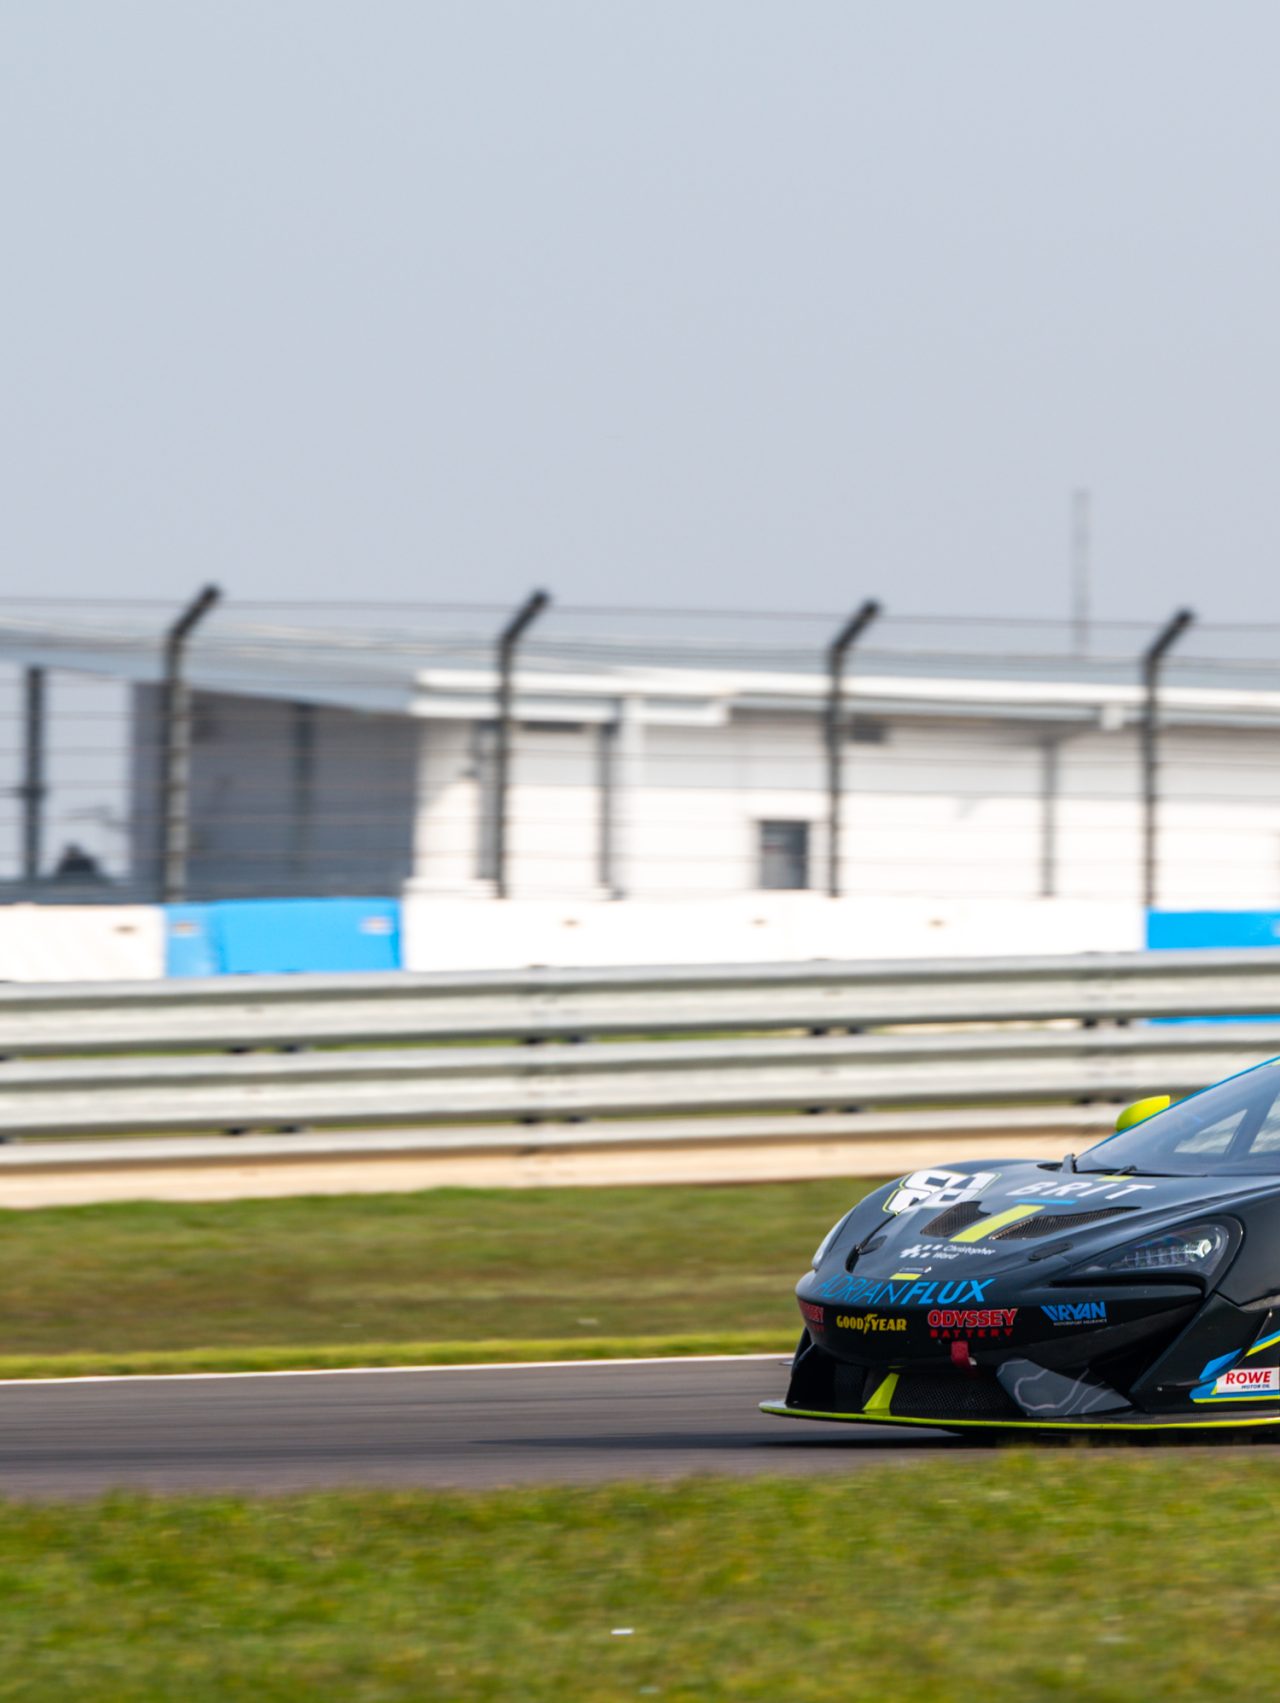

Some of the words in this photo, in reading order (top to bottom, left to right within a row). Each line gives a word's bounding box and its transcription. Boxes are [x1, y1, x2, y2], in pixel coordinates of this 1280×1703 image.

[1006, 1181, 1156, 1200] BRIT
[836, 1313, 907, 1334] GOODYEAR
[928, 1307, 1018, 1328] ODYSSEY
[930, 1327, 1014, 1338] BATTERY
[1226, 1370, 1272, 1384] ROWE
